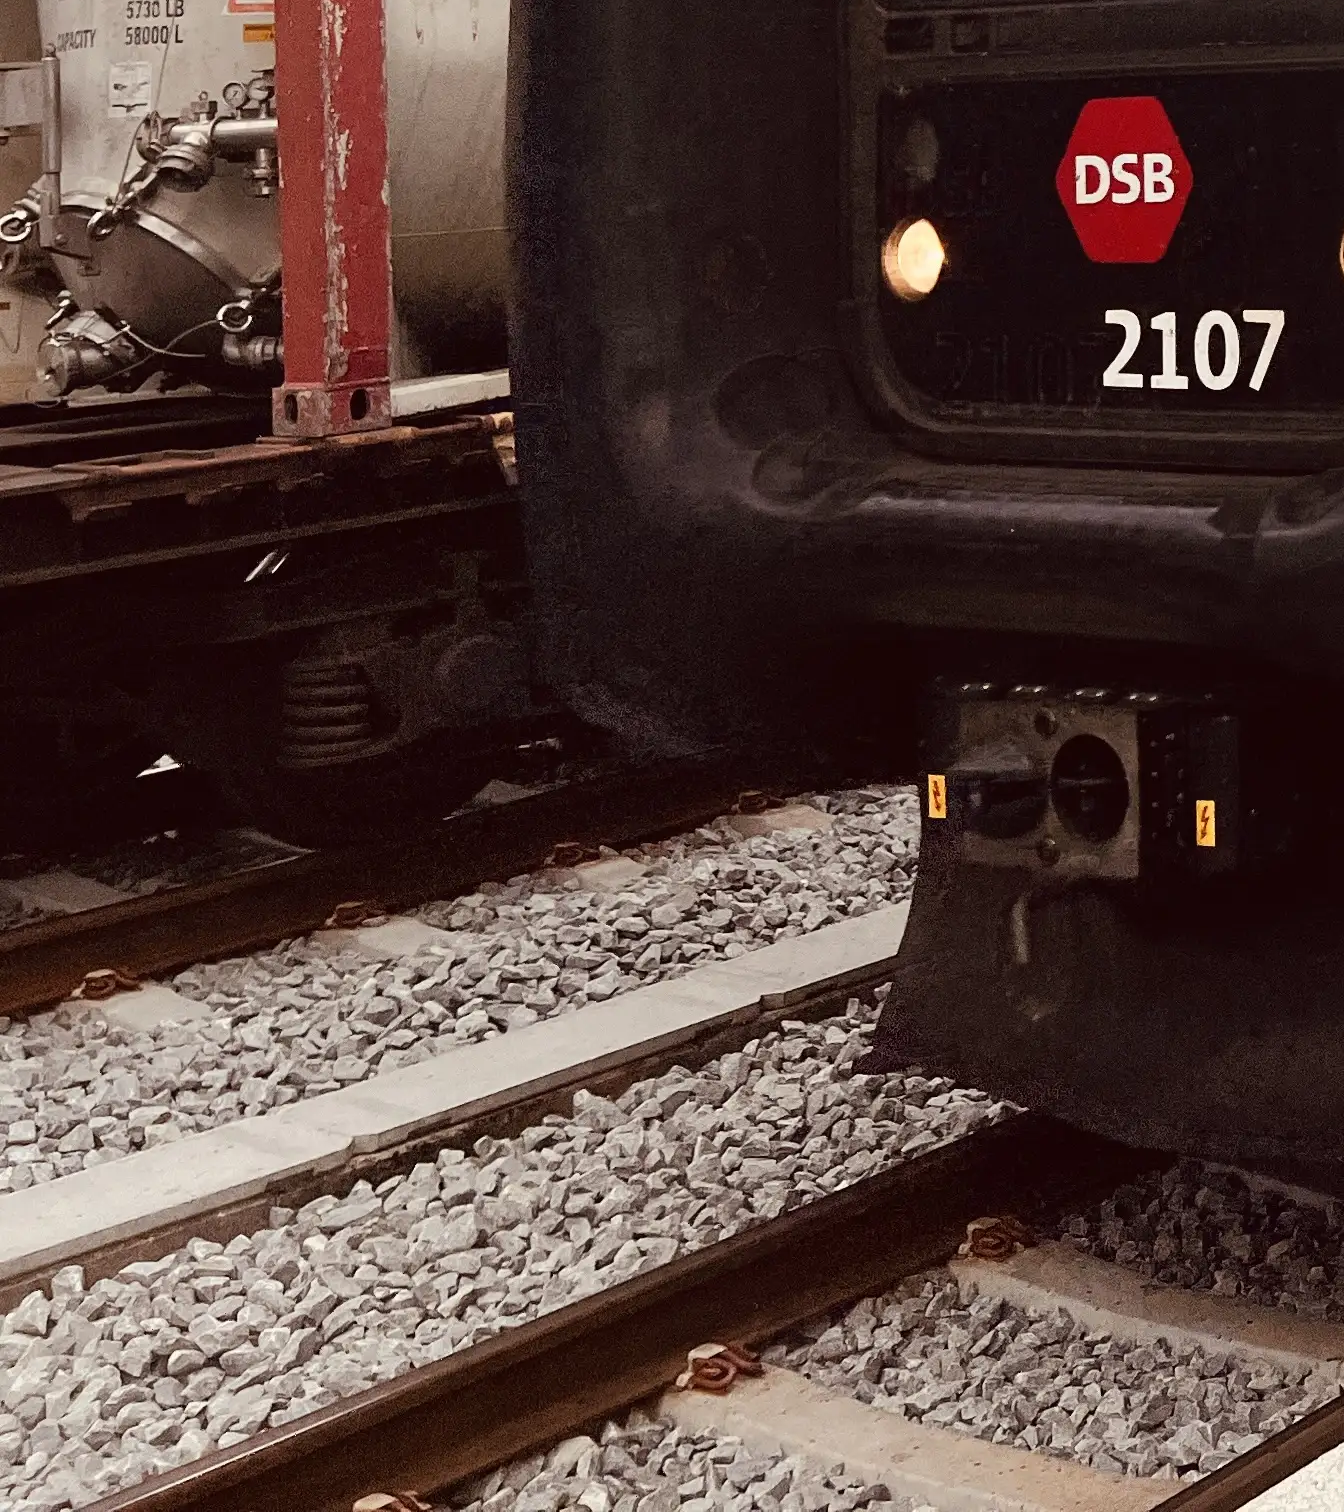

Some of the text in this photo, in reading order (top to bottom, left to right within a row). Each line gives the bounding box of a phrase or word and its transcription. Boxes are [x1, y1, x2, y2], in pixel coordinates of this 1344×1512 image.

[126, 0, 161, 20] 5730
[125, 25, 169, 46] 58000
[174, 24, 184, 44] L
[1075, 153, 1176, 204] DSB
[1102, 309, 1286, 392] 2107
